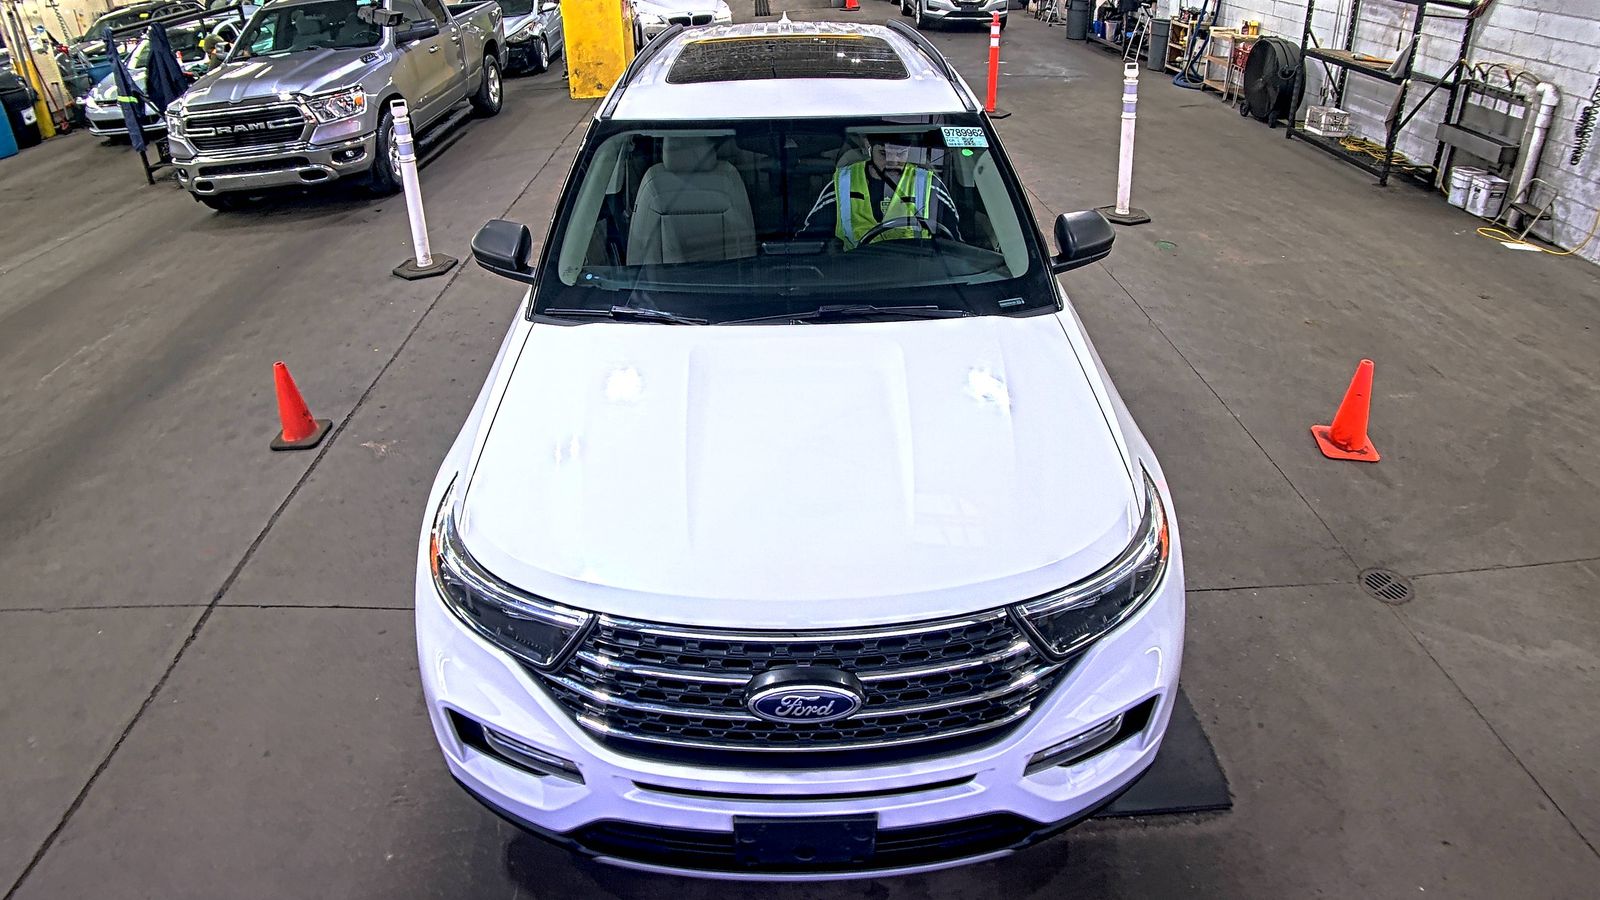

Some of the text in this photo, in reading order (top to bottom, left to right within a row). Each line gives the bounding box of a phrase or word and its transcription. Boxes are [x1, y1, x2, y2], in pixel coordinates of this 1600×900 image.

[217, 123, 265, 134] RAM
[944, 128, 985, 137] 9789962
[776, 695, 834, 717] Ford
